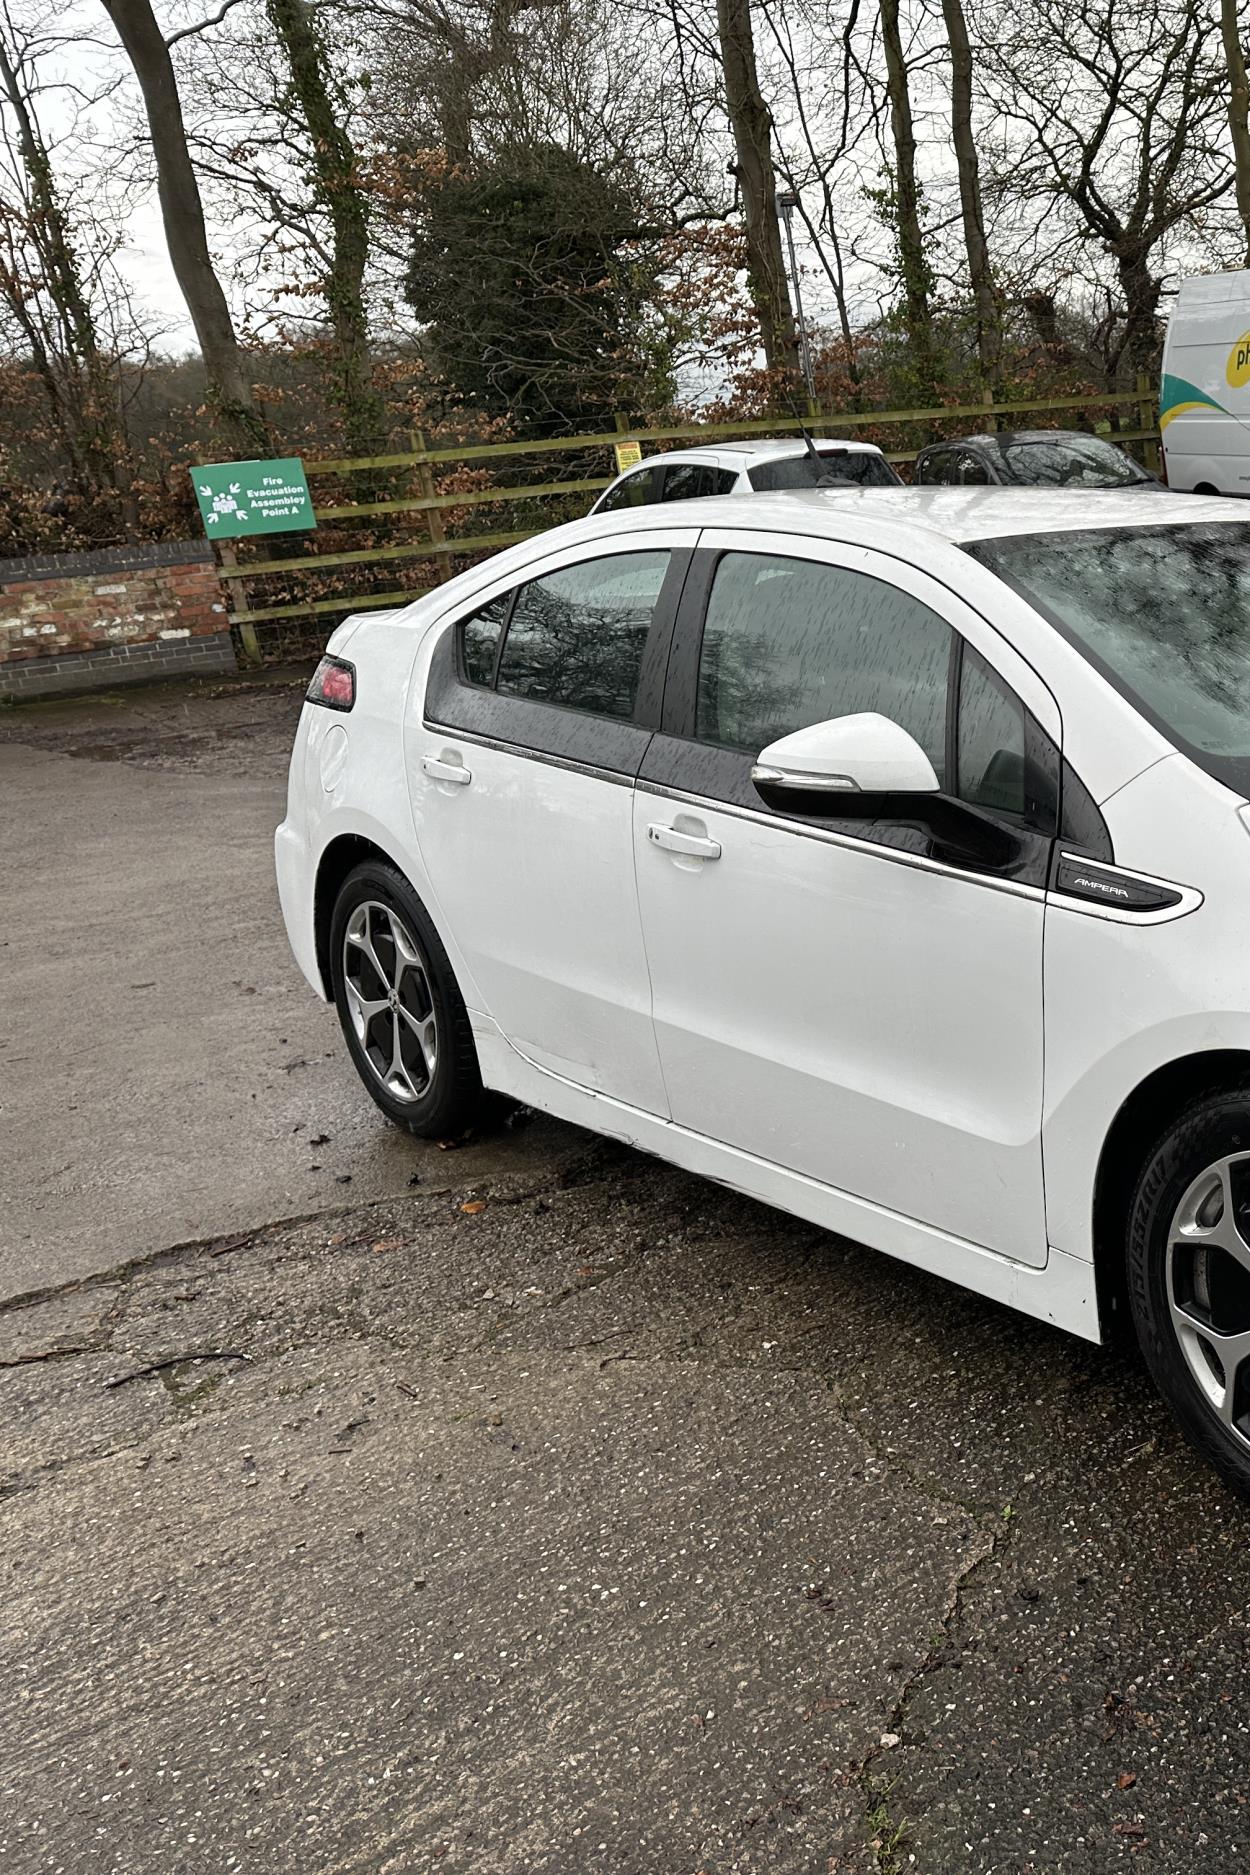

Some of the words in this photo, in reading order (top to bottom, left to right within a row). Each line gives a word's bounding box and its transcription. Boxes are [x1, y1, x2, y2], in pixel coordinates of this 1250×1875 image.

[262, 477, 283, 485] Fire
[247, 486, 304, 497] Evacuation
[262, 507, 290, 517] Point
[291, 506, 299, 514] A
[1074, 878, 1129, 898] AMPERA
